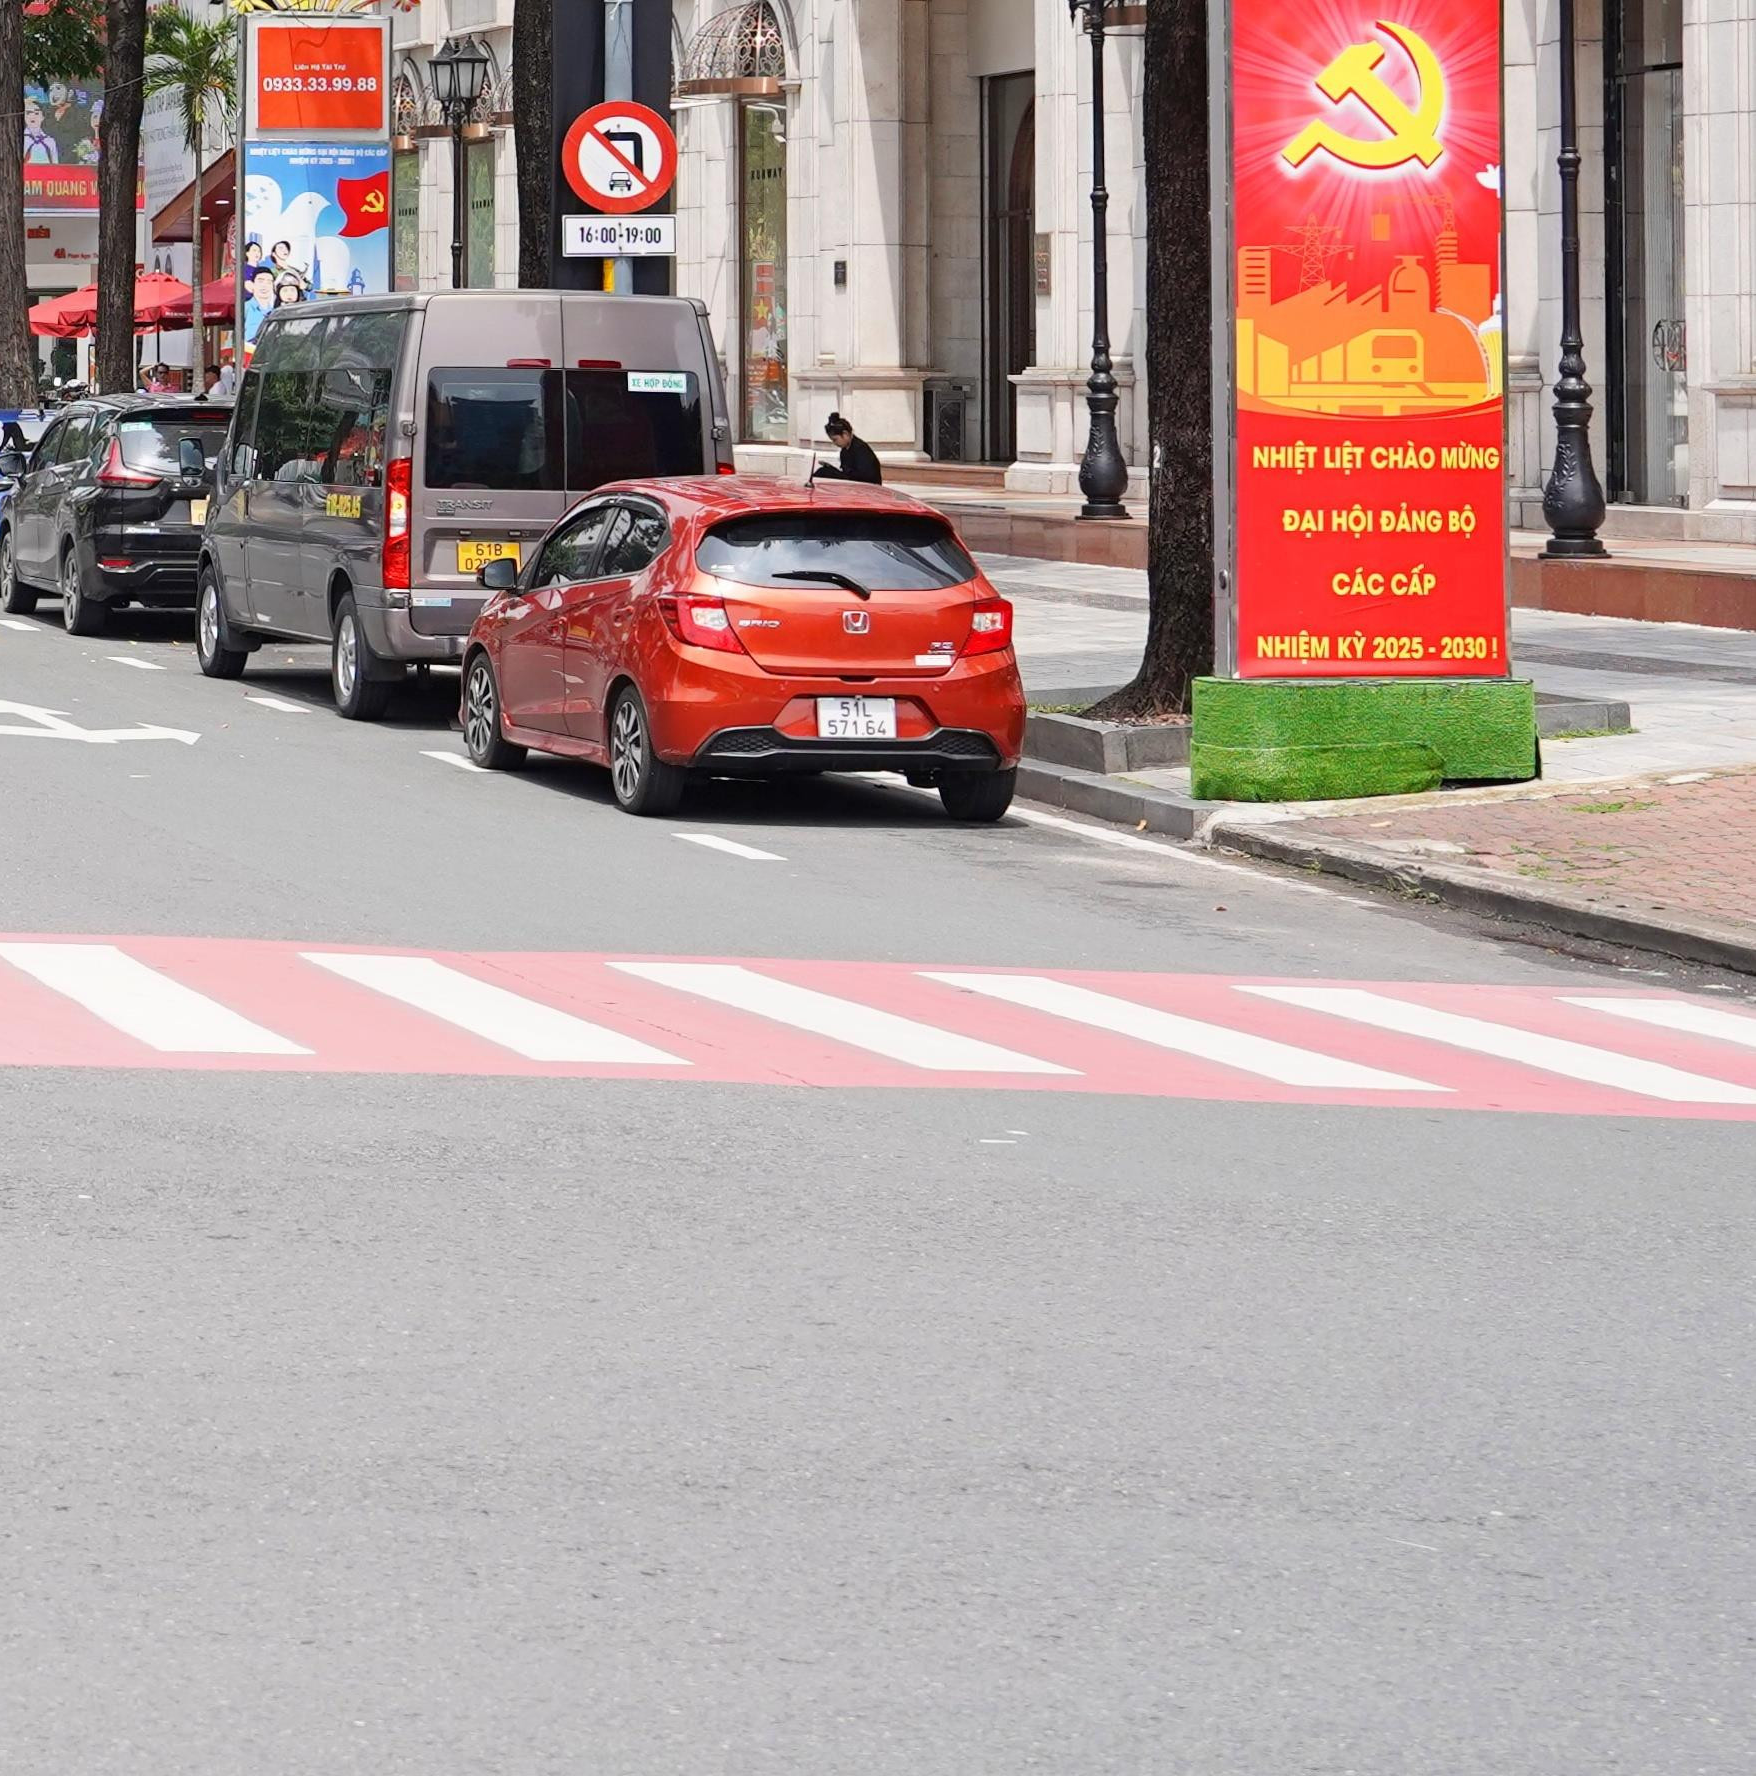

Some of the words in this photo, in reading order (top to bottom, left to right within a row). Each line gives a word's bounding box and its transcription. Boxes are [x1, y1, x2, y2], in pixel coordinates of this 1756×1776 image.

[263, 77, 377, 92] 0933.33.99.88
[46, 181, 86, 196] QUANG
[579, 226, 662, 244] 16:00-19:00
[632, 378, 641, 387] XE
[1153, 446, 1161, 469] 2
[1252, 440, 1317, 475] NHIỆT
[1324, 441, 1365, 476] LIỆT
[1370, 441, 1436, 471] CHÀO
[1441, 443, 1500, 471] MỪNG
[437, 499, 493, 510] TRANSIT
[1283, 508, 1324, 538] ĐẠI
[1332, 504, 1374, 539] HỘI
[1380, 502, 1443, 533] ĐẢNG
[1448, 504, 1476, 539] BỘ
[475, 543, 503, 557] 61B
[1332, 566, 1384, 596] CÁC
[1390, 564, 1436, 596] CẤP
[738, 619, 781, 628] BRIO
[1257, 630, 1330, 665] NHIỆM
[1337, 631, 1367, 660] KỲ
[1372, 637, 1424, 660] 2025
[1440, 637, 1488, 660] 2030
[1492, 637, 1498, 660] !
[840, 701, 873, 718] 51L
[828, 720, 887, 736] 571.64
